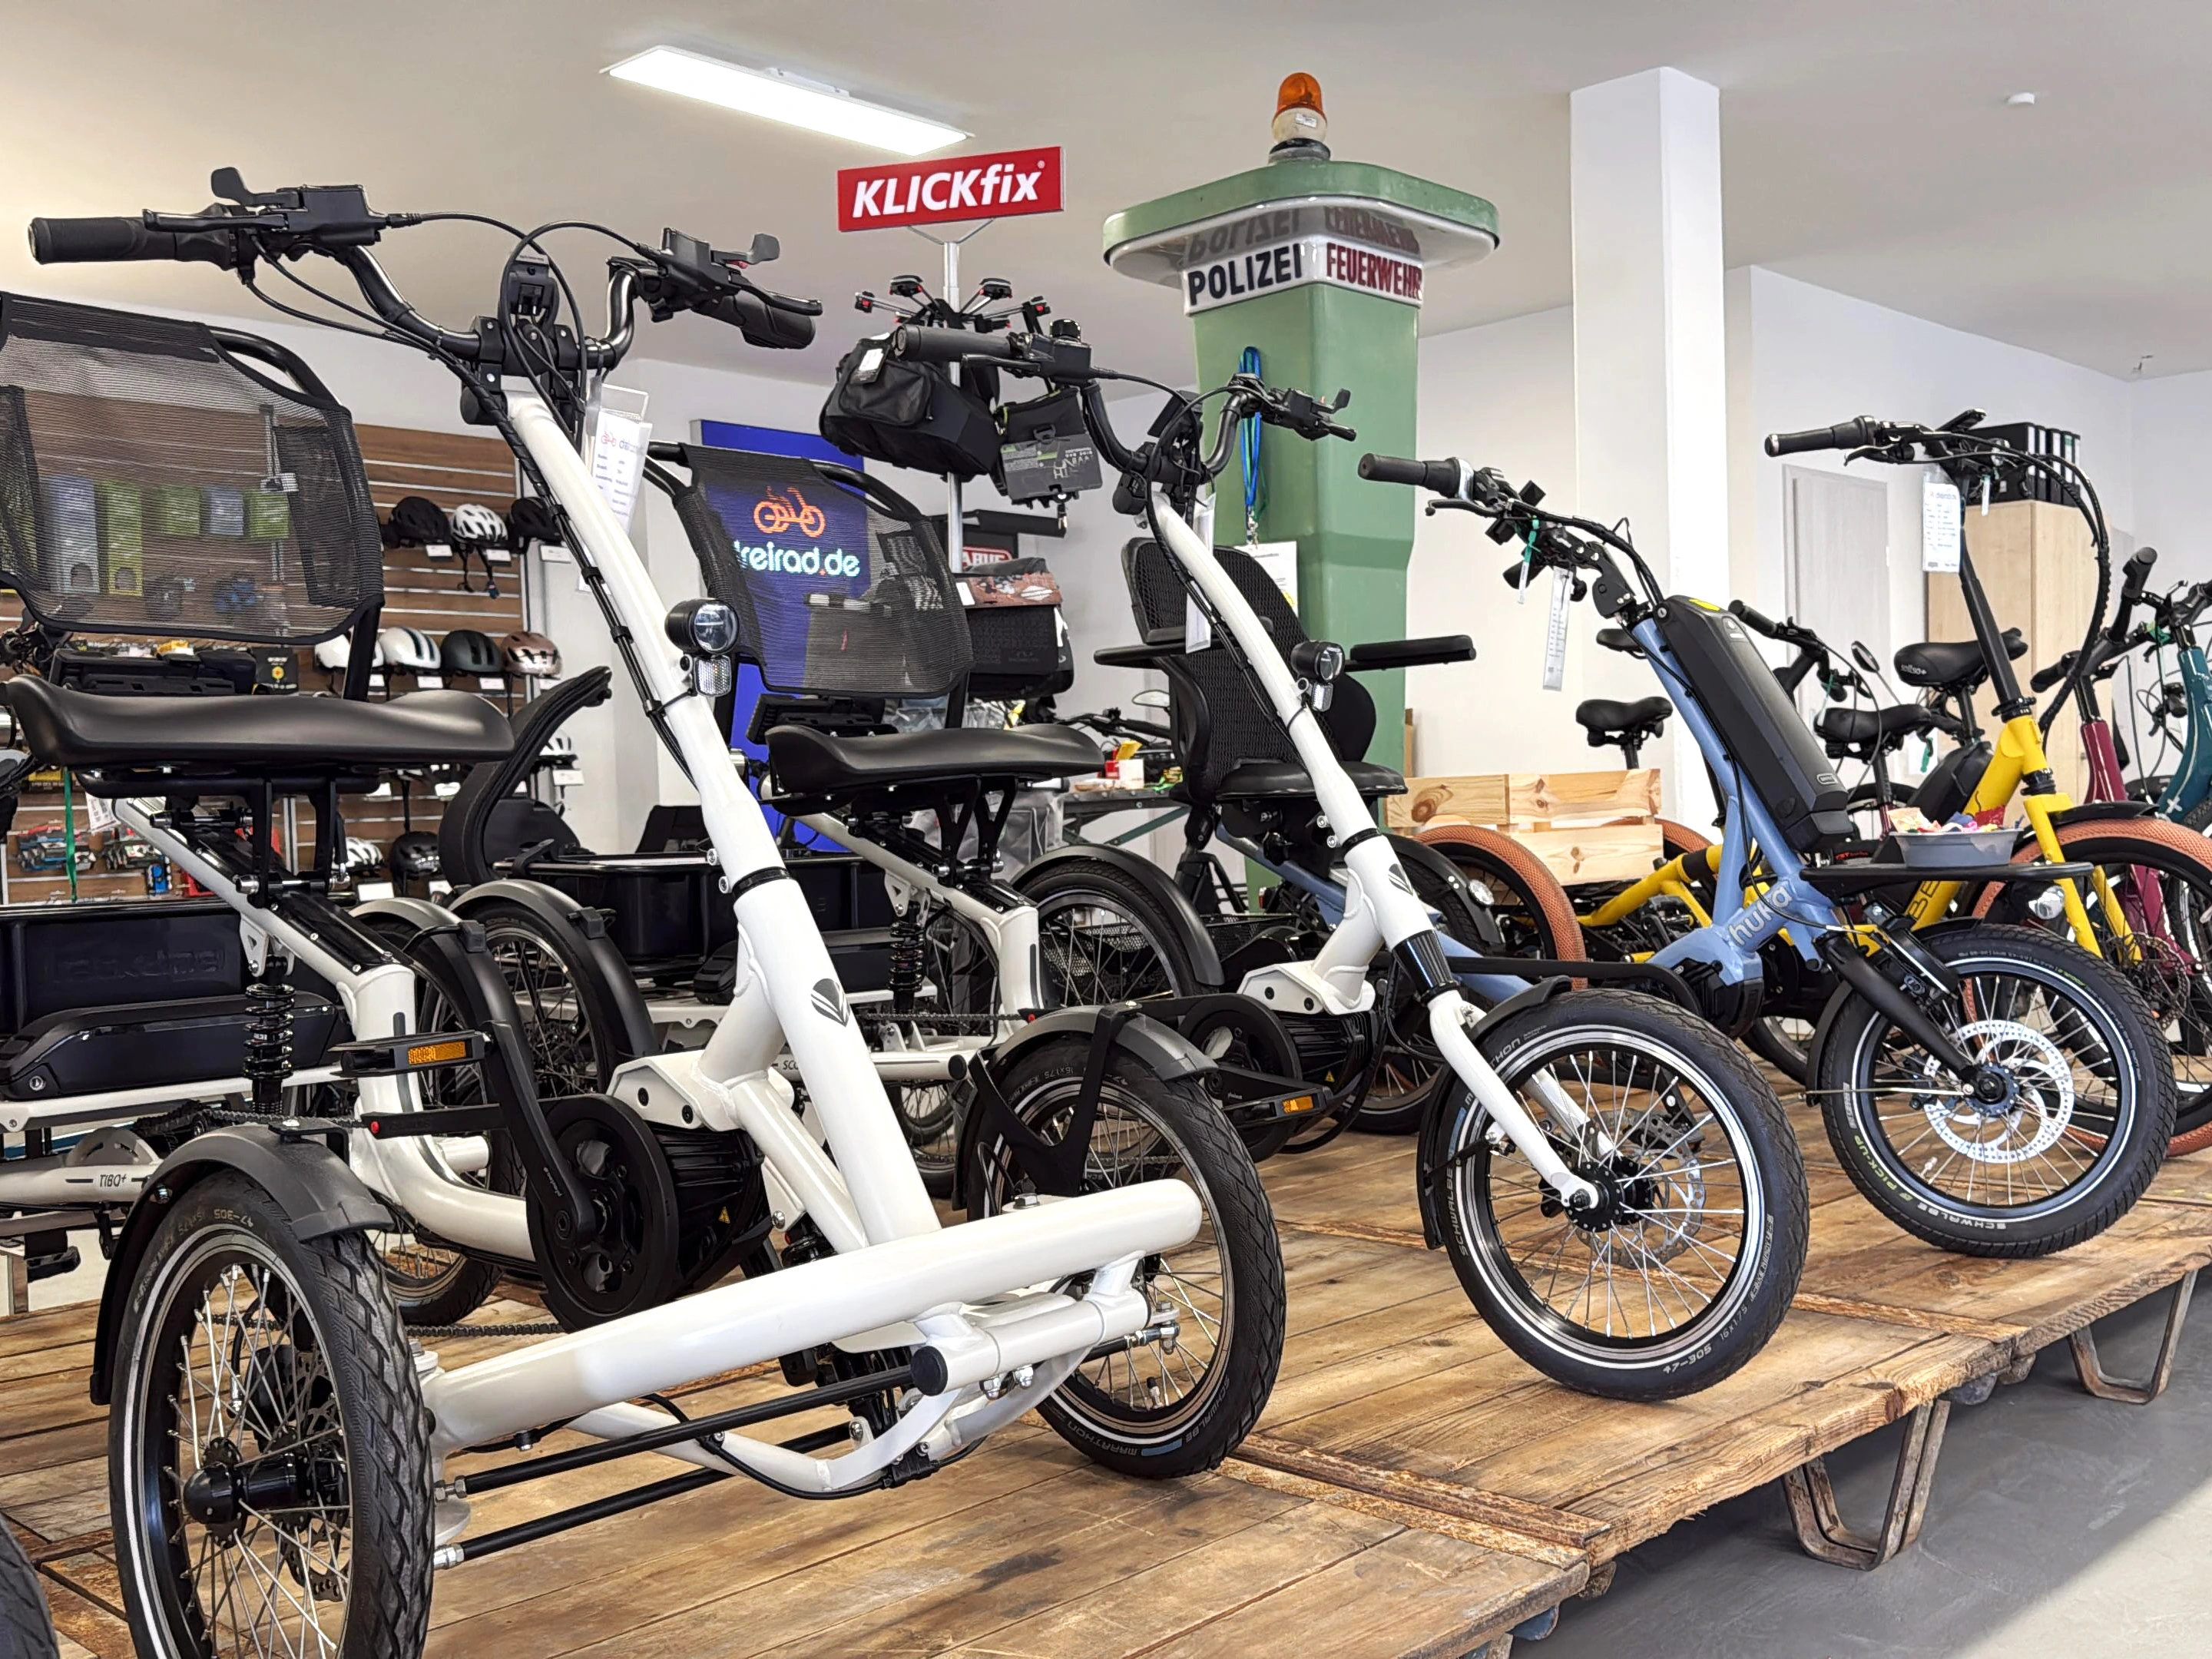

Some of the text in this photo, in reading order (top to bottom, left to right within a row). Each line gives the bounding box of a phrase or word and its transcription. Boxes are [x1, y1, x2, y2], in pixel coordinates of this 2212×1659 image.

[1187, 243, 1303, 306] POLIZEI
[1326, 242, 1422, 300] FEUERWEHR
[733, 539, 860, 576] reirad.de
[1728, 885, 1793, 946] huka
[99, 1174, 127, 1187] TIBO+
[1853, 1134, 2007, 1230] SCHWALBE PICK-UP
[1446, 1167, 1469, 1257] SCHWALBE
[1663, 1343, 1712, 1374] 47-305
[1067, 1377, 1230, 1456] SCHWALBE MARATHON
